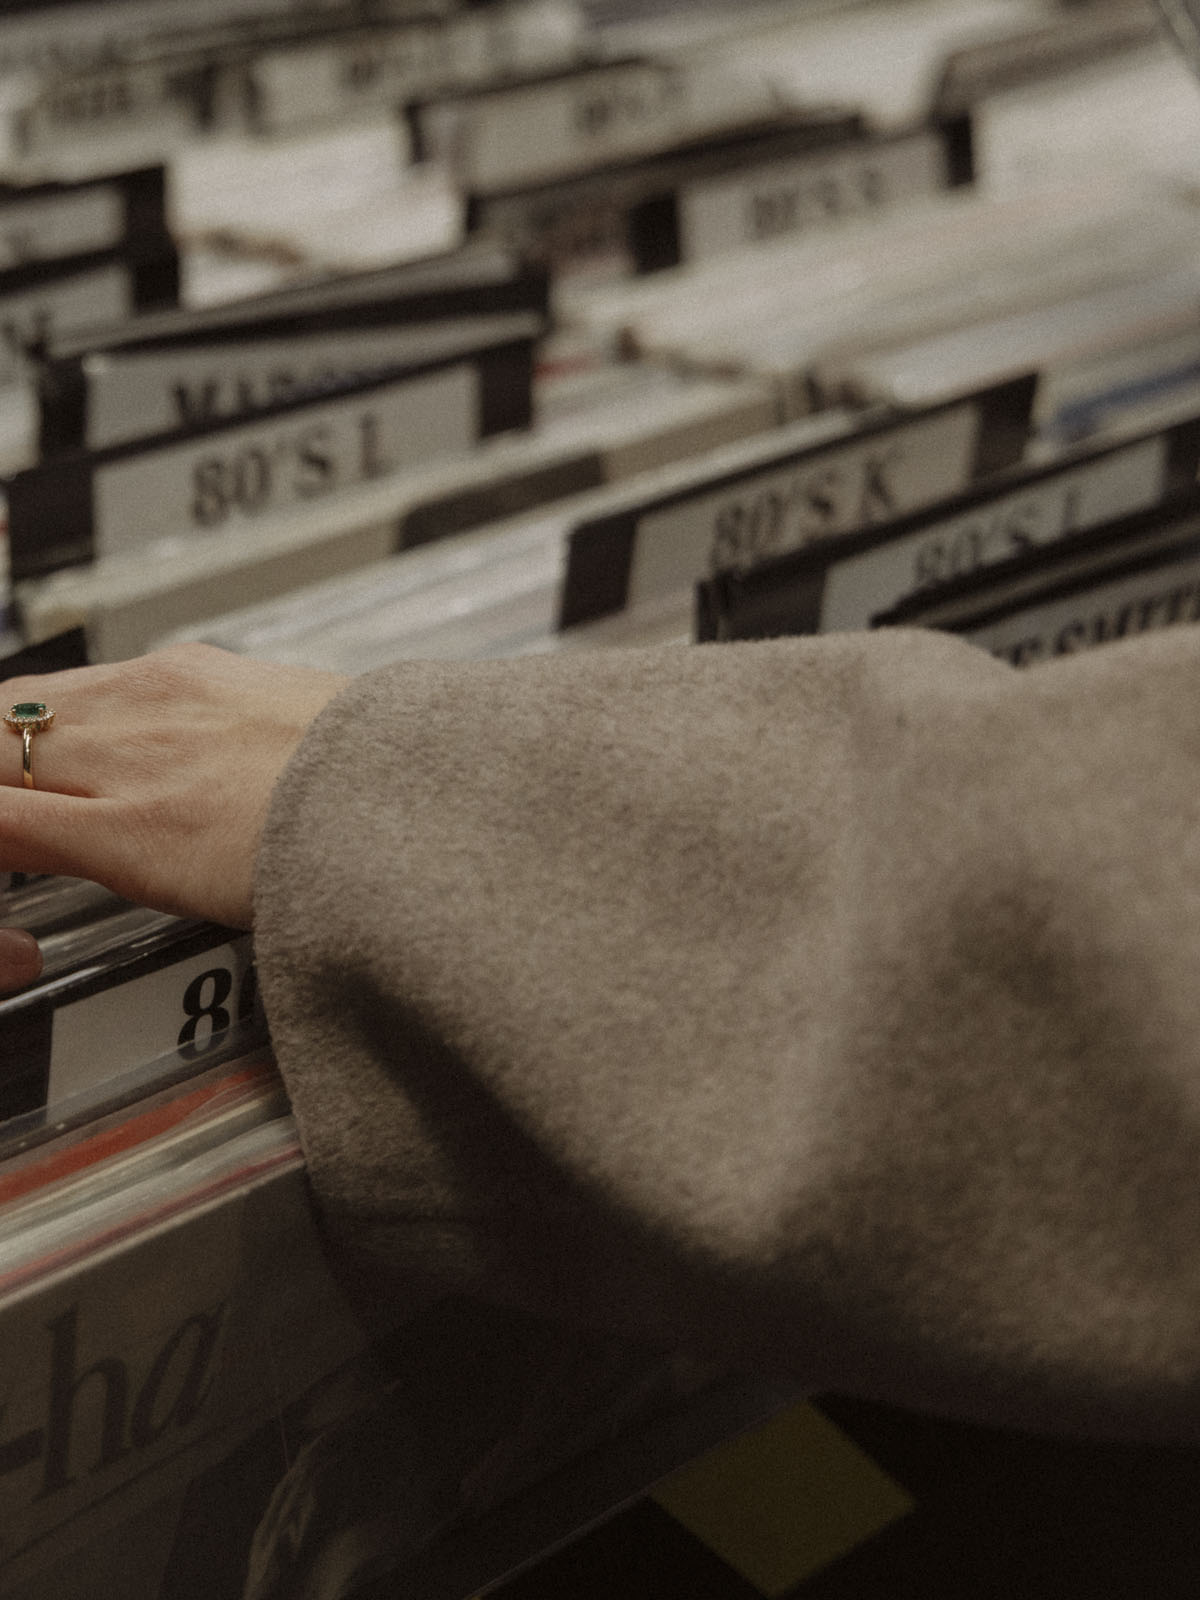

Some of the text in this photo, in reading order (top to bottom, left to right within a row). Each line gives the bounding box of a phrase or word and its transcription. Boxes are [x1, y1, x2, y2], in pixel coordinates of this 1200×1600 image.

[189, 411, 400, 532] 80'S L
[710, 447, 903, 572] 80'S K
